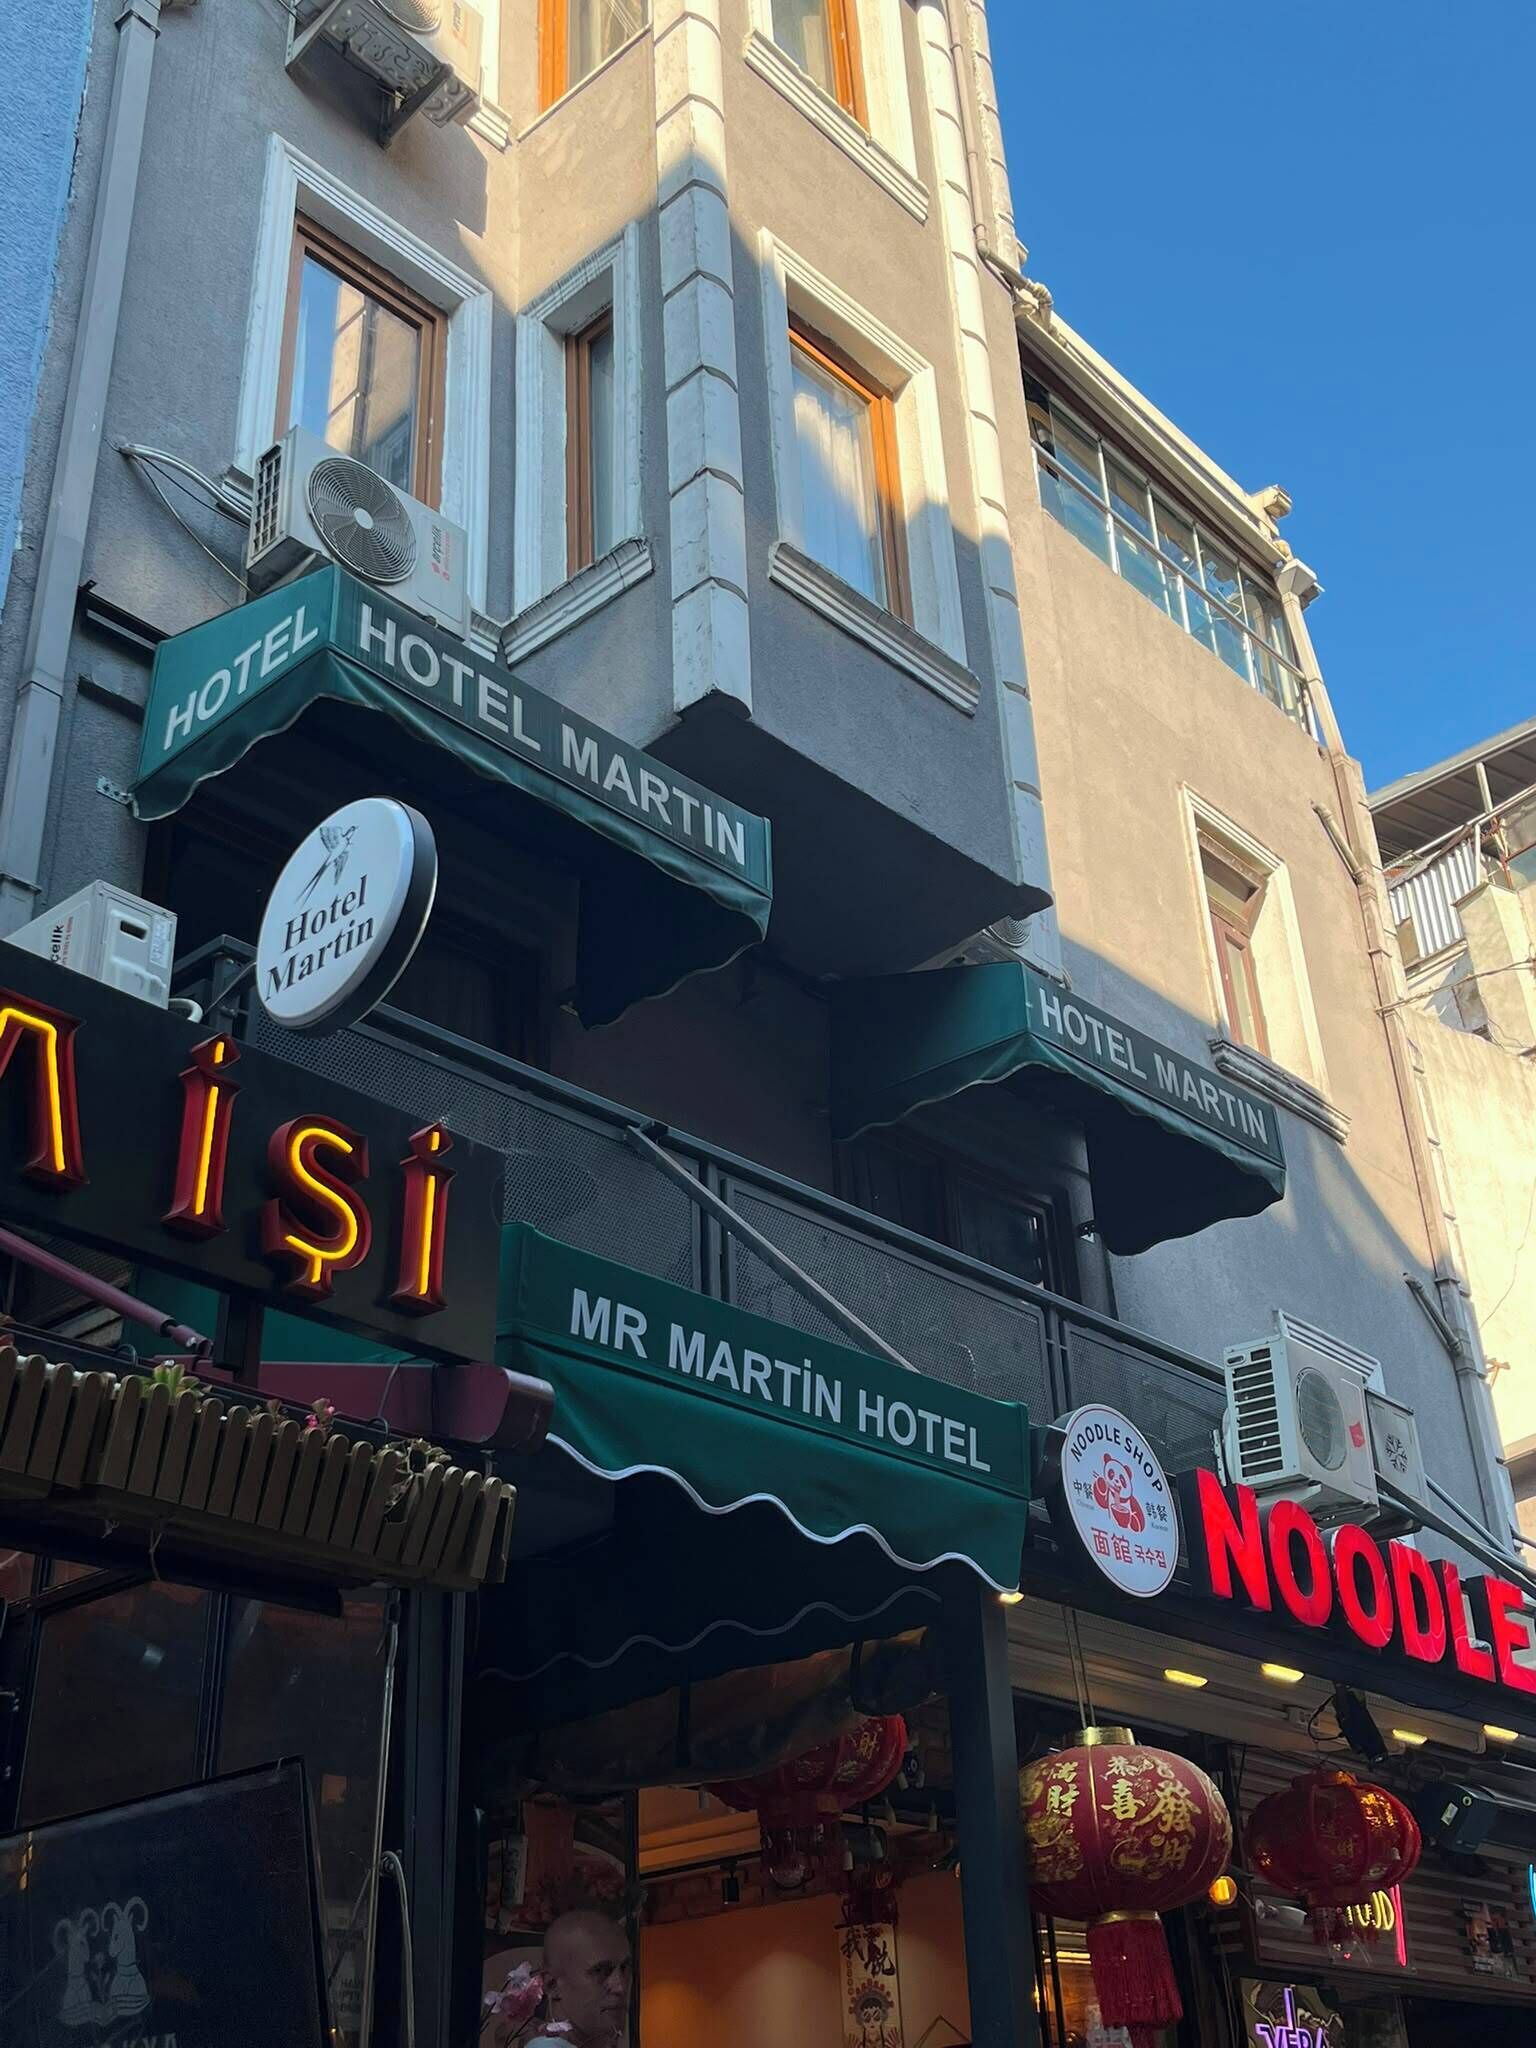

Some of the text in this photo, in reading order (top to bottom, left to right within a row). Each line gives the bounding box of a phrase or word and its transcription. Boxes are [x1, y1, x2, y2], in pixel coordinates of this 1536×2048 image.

[163, 605, 319, 751] HOTEL
[359, 602, 745, 866] HOTEL MARTIN
[264, 917, 374, 1002] Martin
[283, 874, 368, 953] Hotel
[1039, 987, 1269, 1145] HOTEL MARTIN
[570, 1288, 992, 1473] MR MARTİN HOTEL
[1070, 1423, 1164, 1493] NOODLE SHOP
[1134, 1544, 1167, 1569] 국수집
[1196, 1468, 1536, 1695] NOODLE
